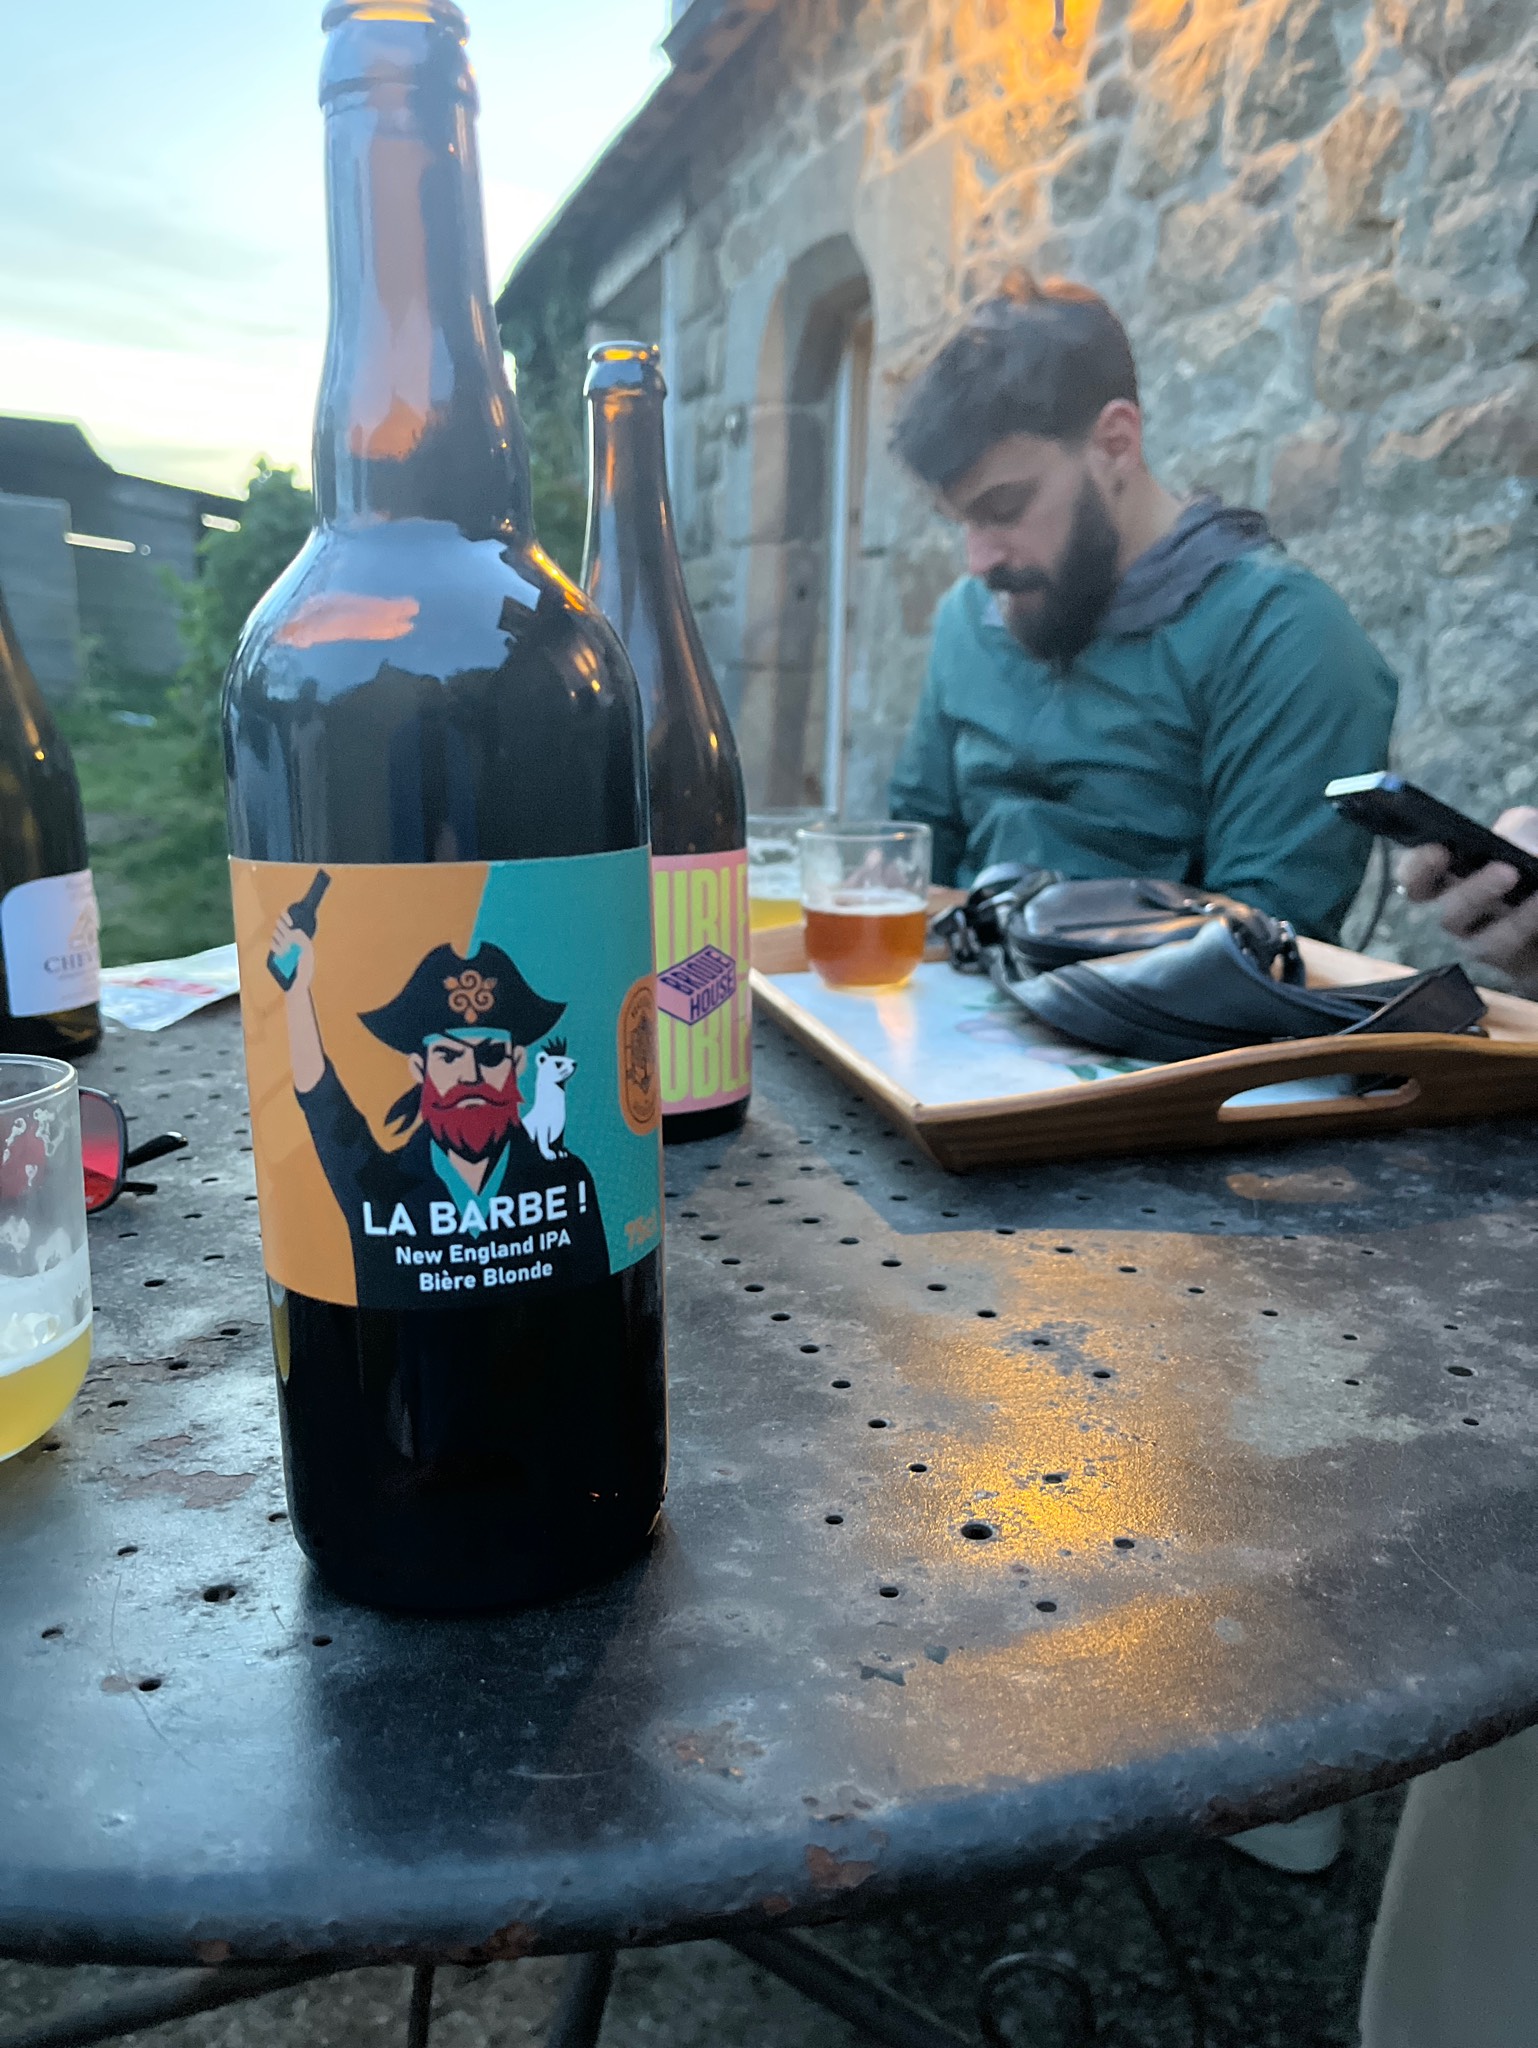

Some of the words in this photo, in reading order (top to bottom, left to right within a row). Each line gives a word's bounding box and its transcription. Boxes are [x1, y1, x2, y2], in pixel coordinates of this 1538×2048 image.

[690, 967, 734, 1020] HOUSE
[363, 1201, 417, 1236] LA
[429, 1185, 568, 1236] BARBE
[578, 1180, 587, 1214] !
[395, 1246, 443, 1265] New
[449, 1241, 534, 1265] England
[539, 1228, 572, 1251] IPA
[419, 1270, 476, 1292] Bière
[483, 1261, 553, 1287] Blonde
